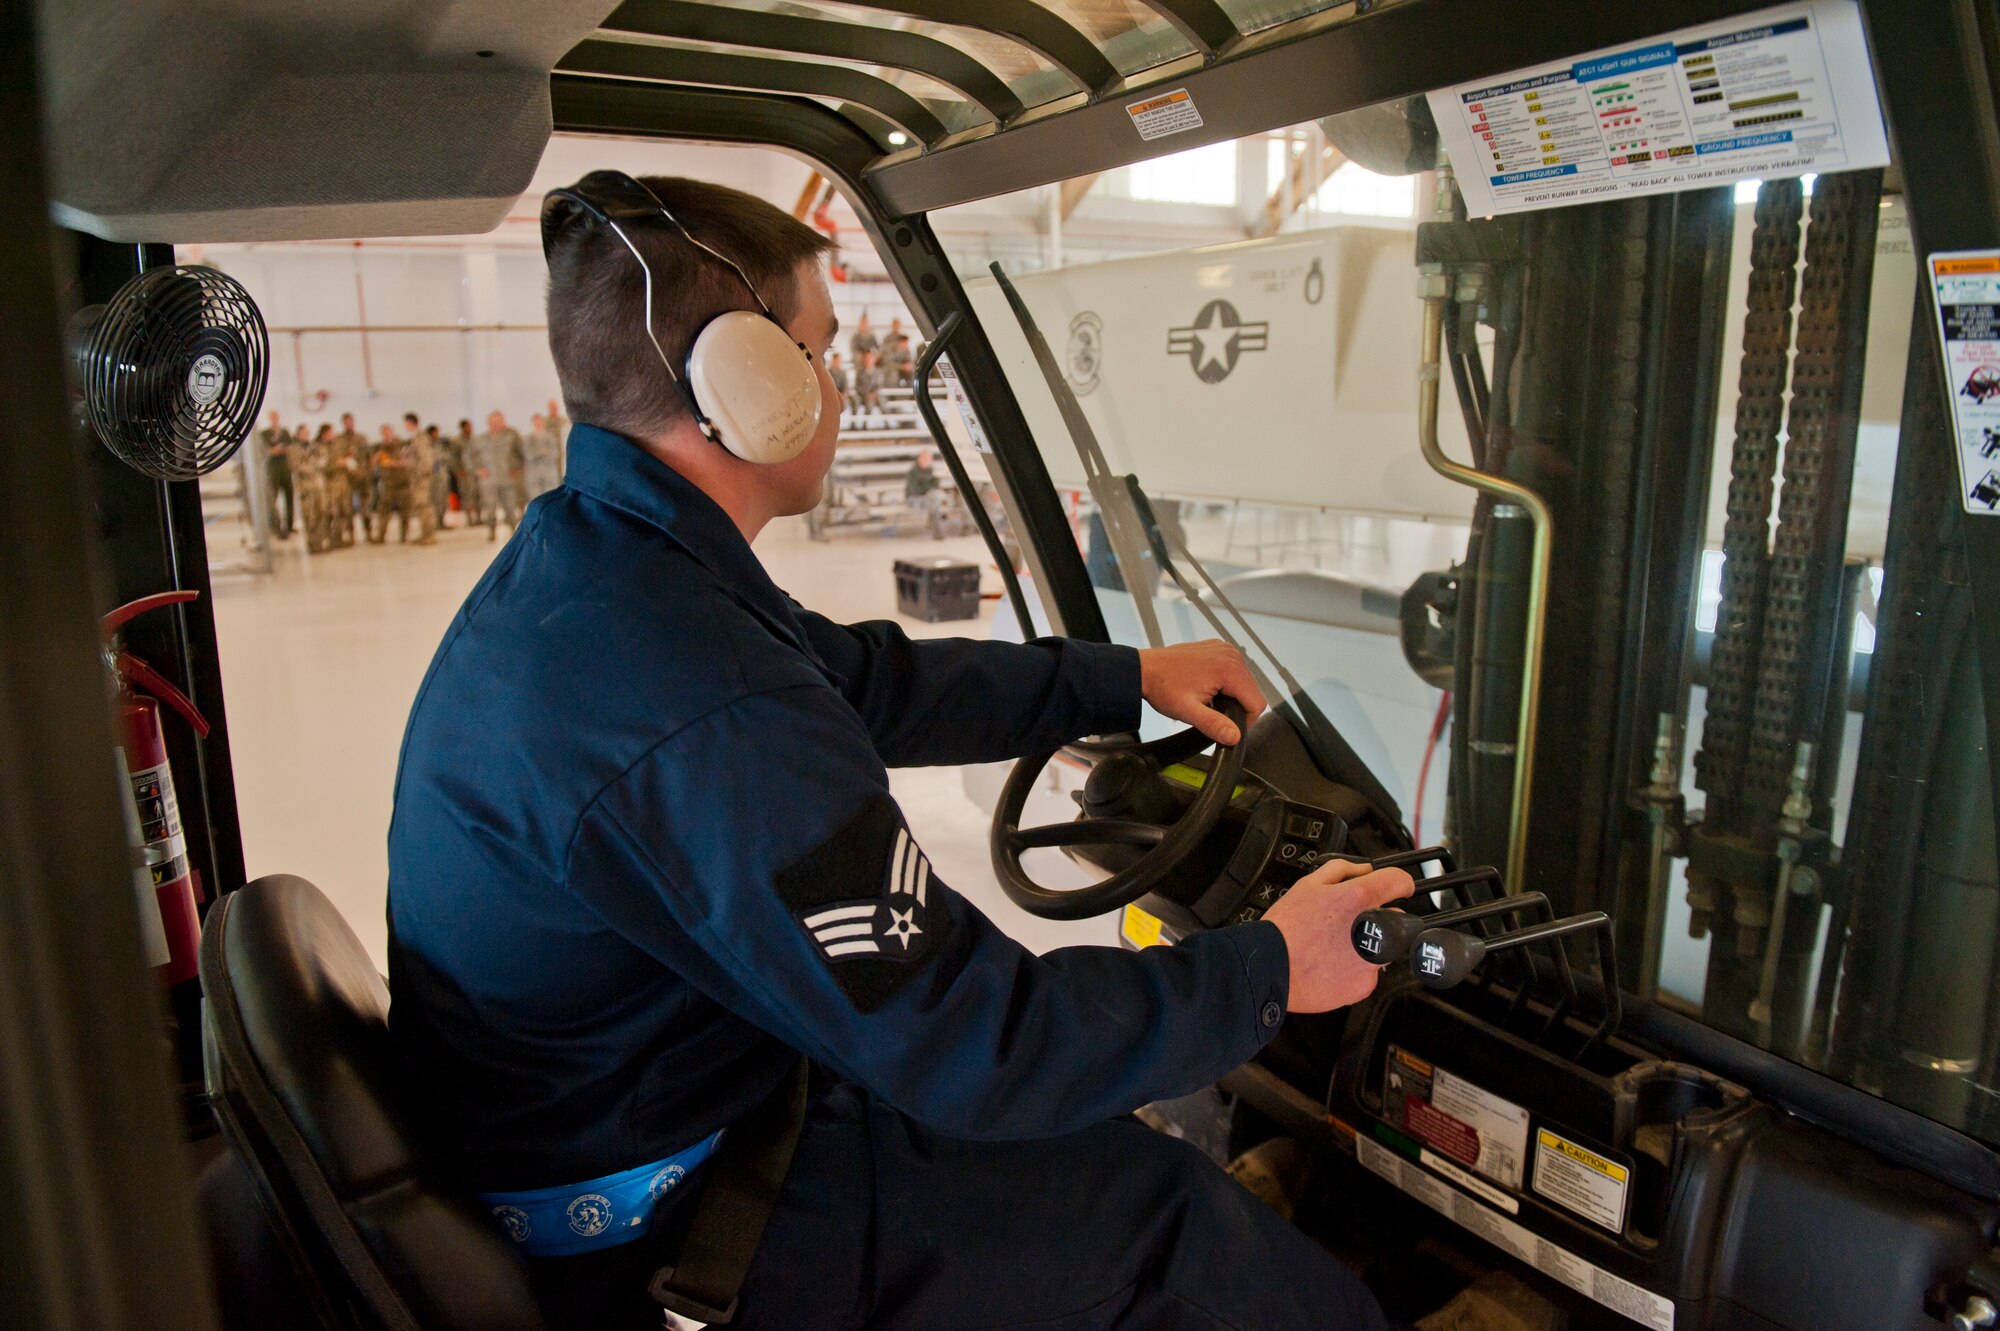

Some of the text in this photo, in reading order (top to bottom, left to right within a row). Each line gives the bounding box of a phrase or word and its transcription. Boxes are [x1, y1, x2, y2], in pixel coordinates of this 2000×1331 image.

[1707, 28, 1774, 48] Airport Markings
[1597, 61, 1619, 72] LIGHT
[1620, 57, 1638, 67] GUN
[1638, 50, 1671, 63] SIGNALS
[1466, 89, 1487, 102] Airport
[1487, 85, 1505, 97] Signs
[1510, 80, 1531, 91] Action
[1531, 78, 1544, 88] and
[1544, 72, 1571, 84] Purpose
[1149, 97, 1172, 109] WARNING
[1701, 138, 1736, 151] GROUND
[1736, 132, 1787, 147] FREQUENCY
[1502, 168, 1564, 183] TOWER FREQUENCY
[1524, 193, 1551, 203] PREVENT
[1551, 190, 1578, 200] RUNWAY
[1579, 184, 1619, 195] INCURSIONS
[1673, 171, 1686, 180] ALL
[1687, 168, 1713, 179] TOWER
[1714, 163, 1769, 175] INSTRUCTIONS
[1770, 156, 1815, 169] VERBATIM!
[193, 358, 222, 377] MARADYNE
[1567, 1142, 1608, 1173] CAUTION
[1464, 1174, 1506, 1204] Transmission
